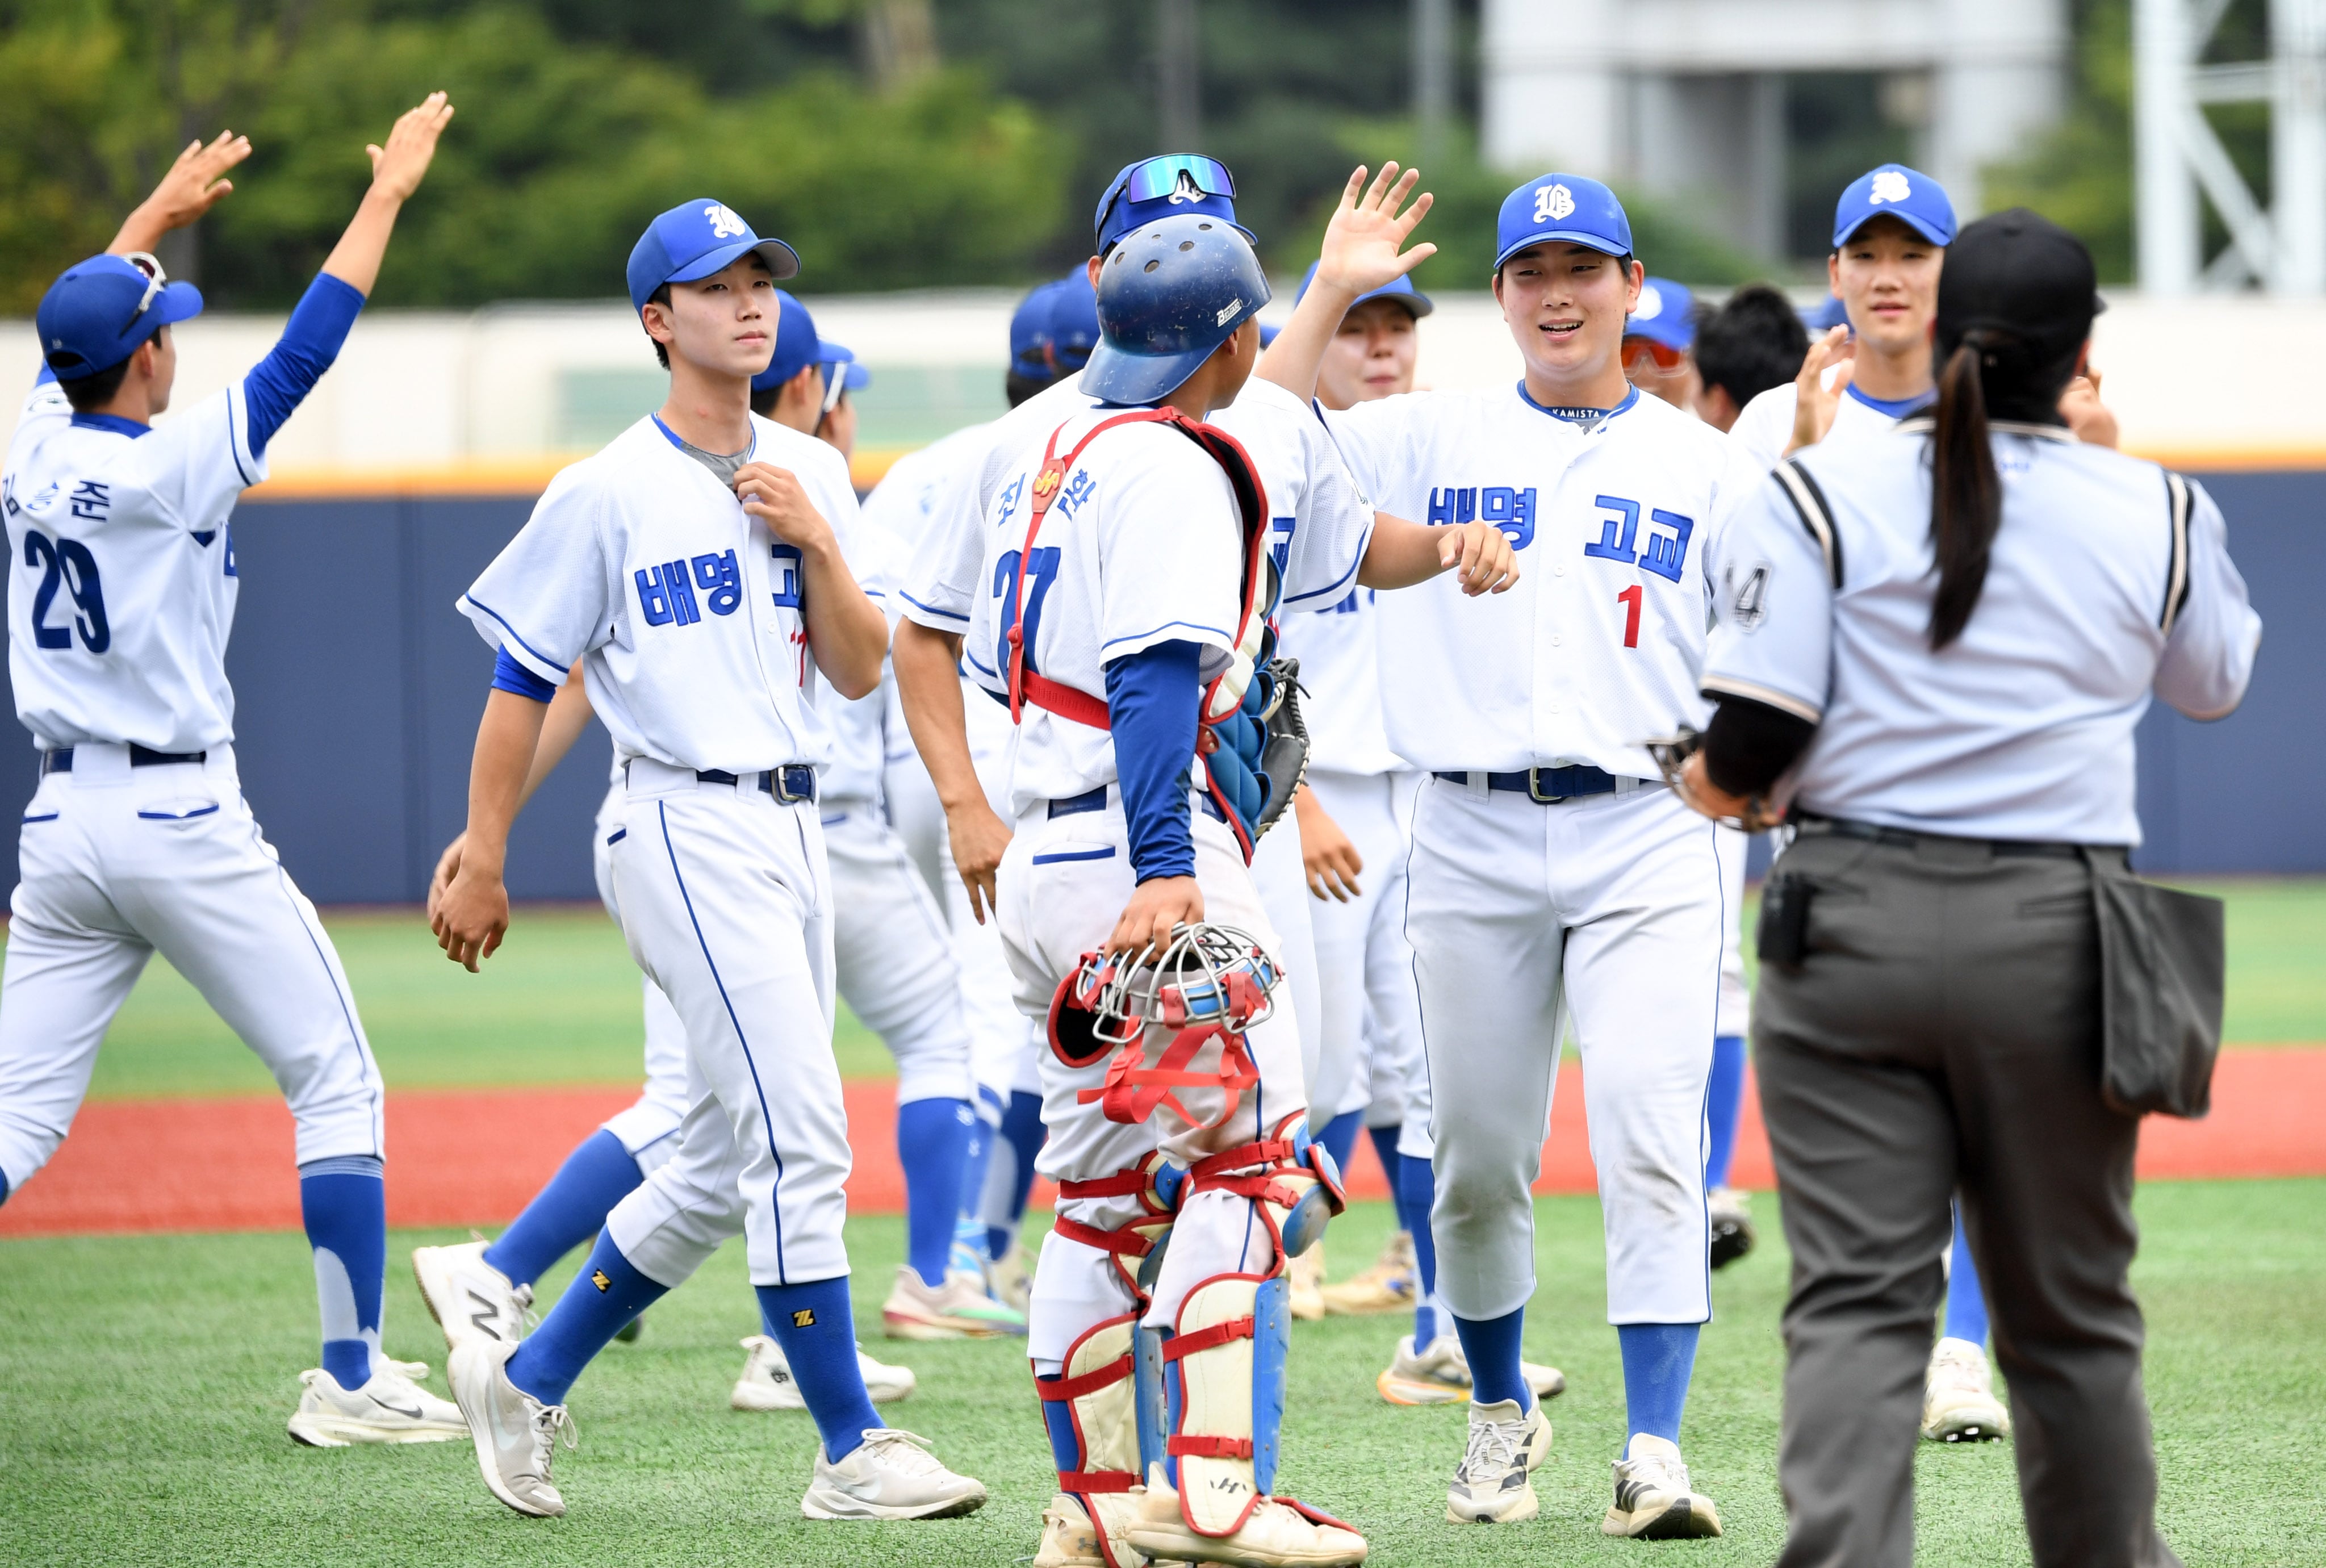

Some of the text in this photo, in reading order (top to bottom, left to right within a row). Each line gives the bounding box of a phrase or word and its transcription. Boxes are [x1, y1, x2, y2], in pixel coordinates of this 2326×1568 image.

[1584, 494, 1694, 584] 고교
[24, 529, 110, 654] 29
[634, 548, 742, 627] 배명
[1618, 584, 1642, 648] 1
